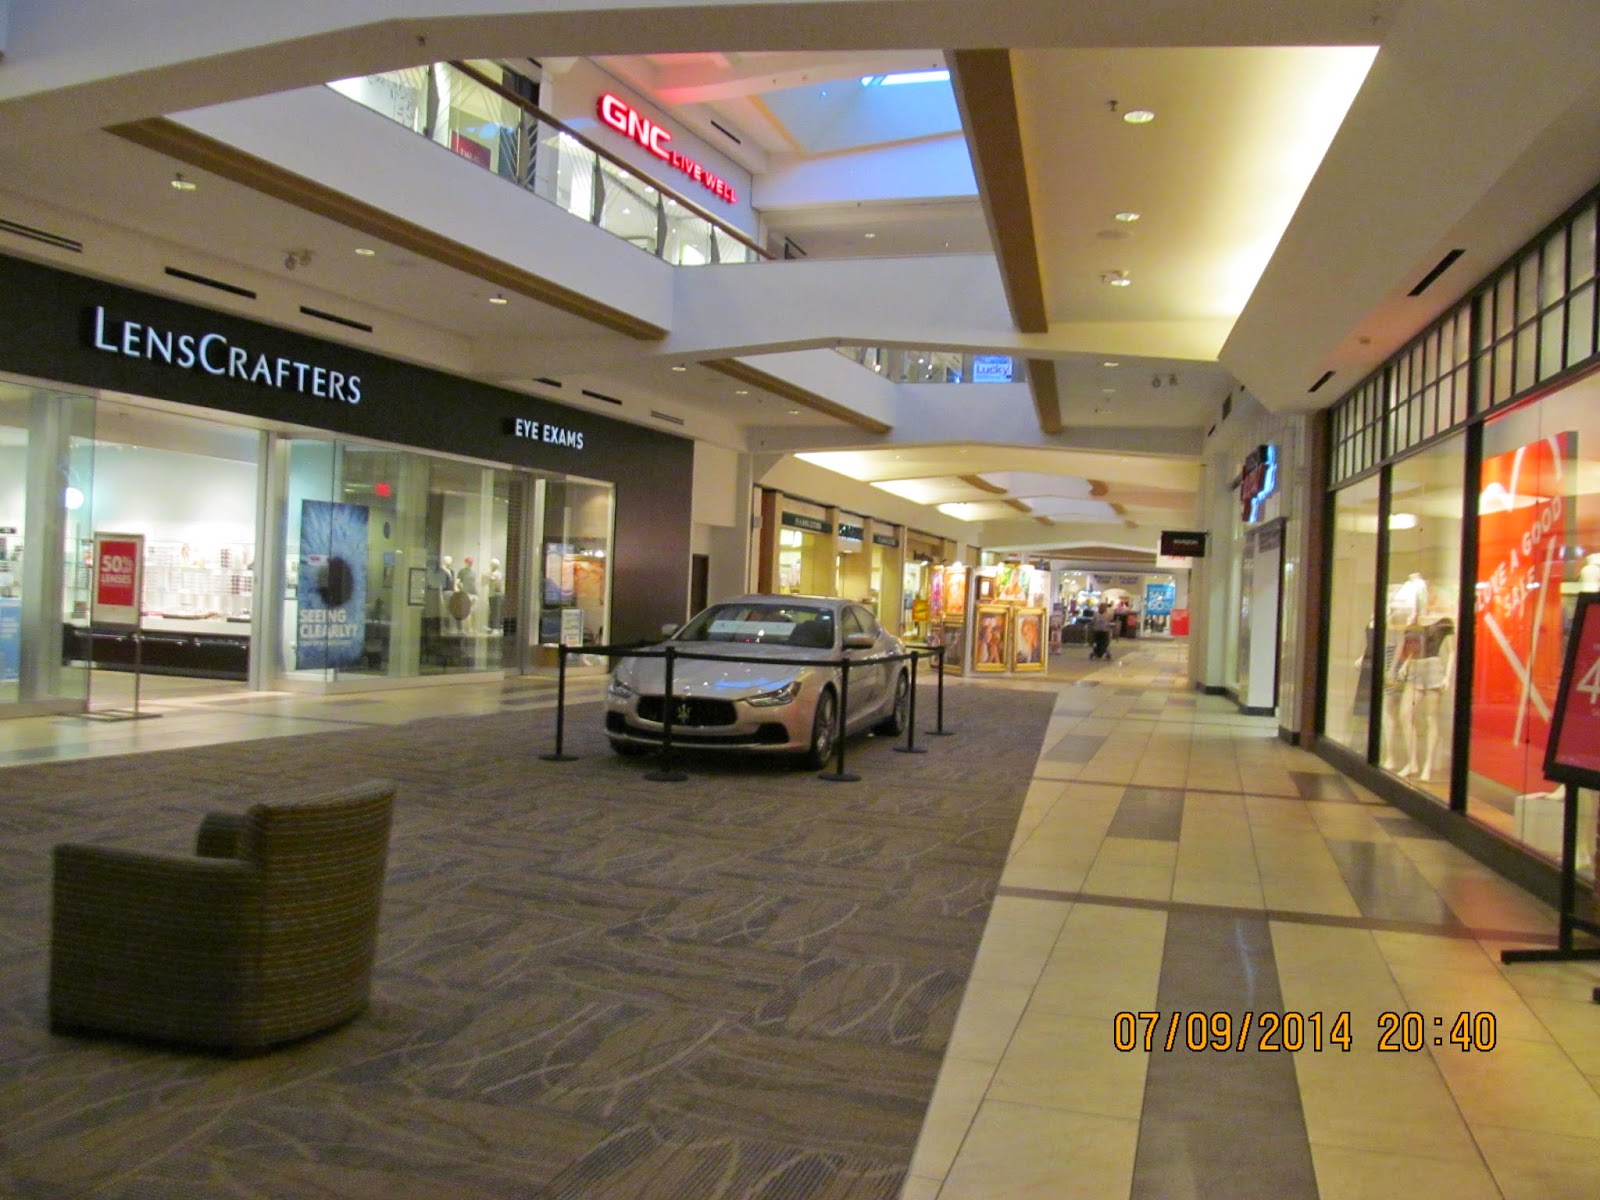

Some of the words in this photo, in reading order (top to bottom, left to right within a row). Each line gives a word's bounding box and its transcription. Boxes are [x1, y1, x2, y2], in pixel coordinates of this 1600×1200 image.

[600, 93, 672, 160] GNC
[673, 151, 702, 181] LIVE
[704, 171, 737, 204] WELL
[515, 418, 539, 440] EYE
[543, 424, 584, 450] EXAMS
[1522, 495, 1563, 556] GOOD
[299, 608, 347, 624] SEEING
